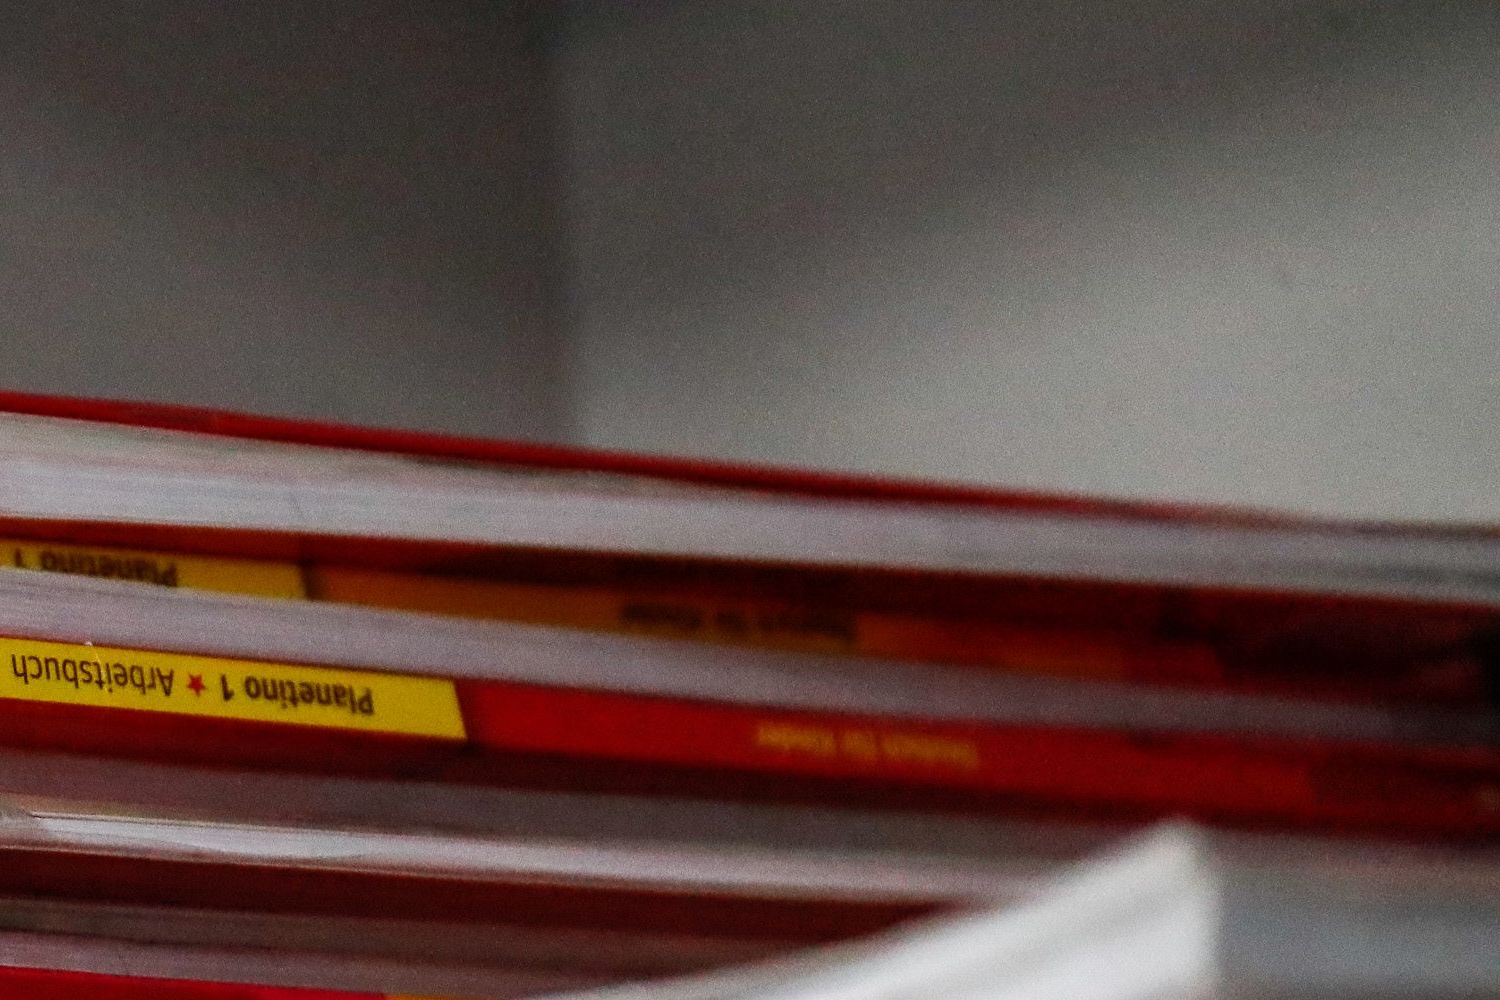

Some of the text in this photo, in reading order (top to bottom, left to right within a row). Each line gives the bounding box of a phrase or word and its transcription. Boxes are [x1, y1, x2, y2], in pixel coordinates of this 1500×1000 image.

[11, 653, 375, 716] Planetino 1 Arbeitsbuch
